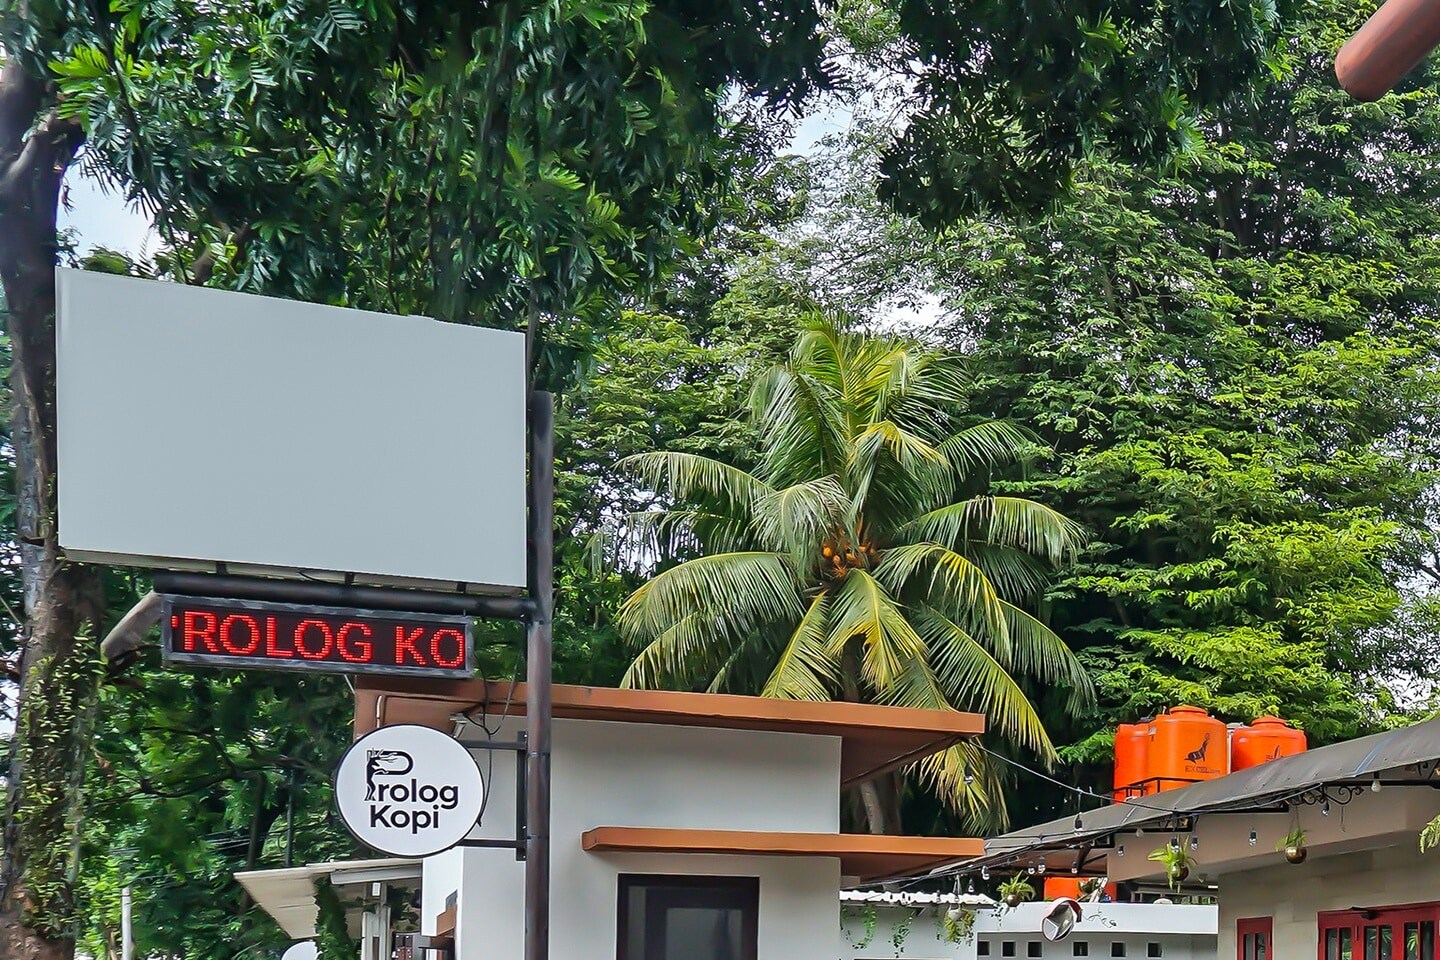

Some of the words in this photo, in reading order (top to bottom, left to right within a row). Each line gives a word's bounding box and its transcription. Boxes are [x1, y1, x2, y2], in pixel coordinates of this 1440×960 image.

[171, 610, 373, 663] ROLOG
[394, 624, 465, 667] KO
[370, 804, 439, 835] Kopi
